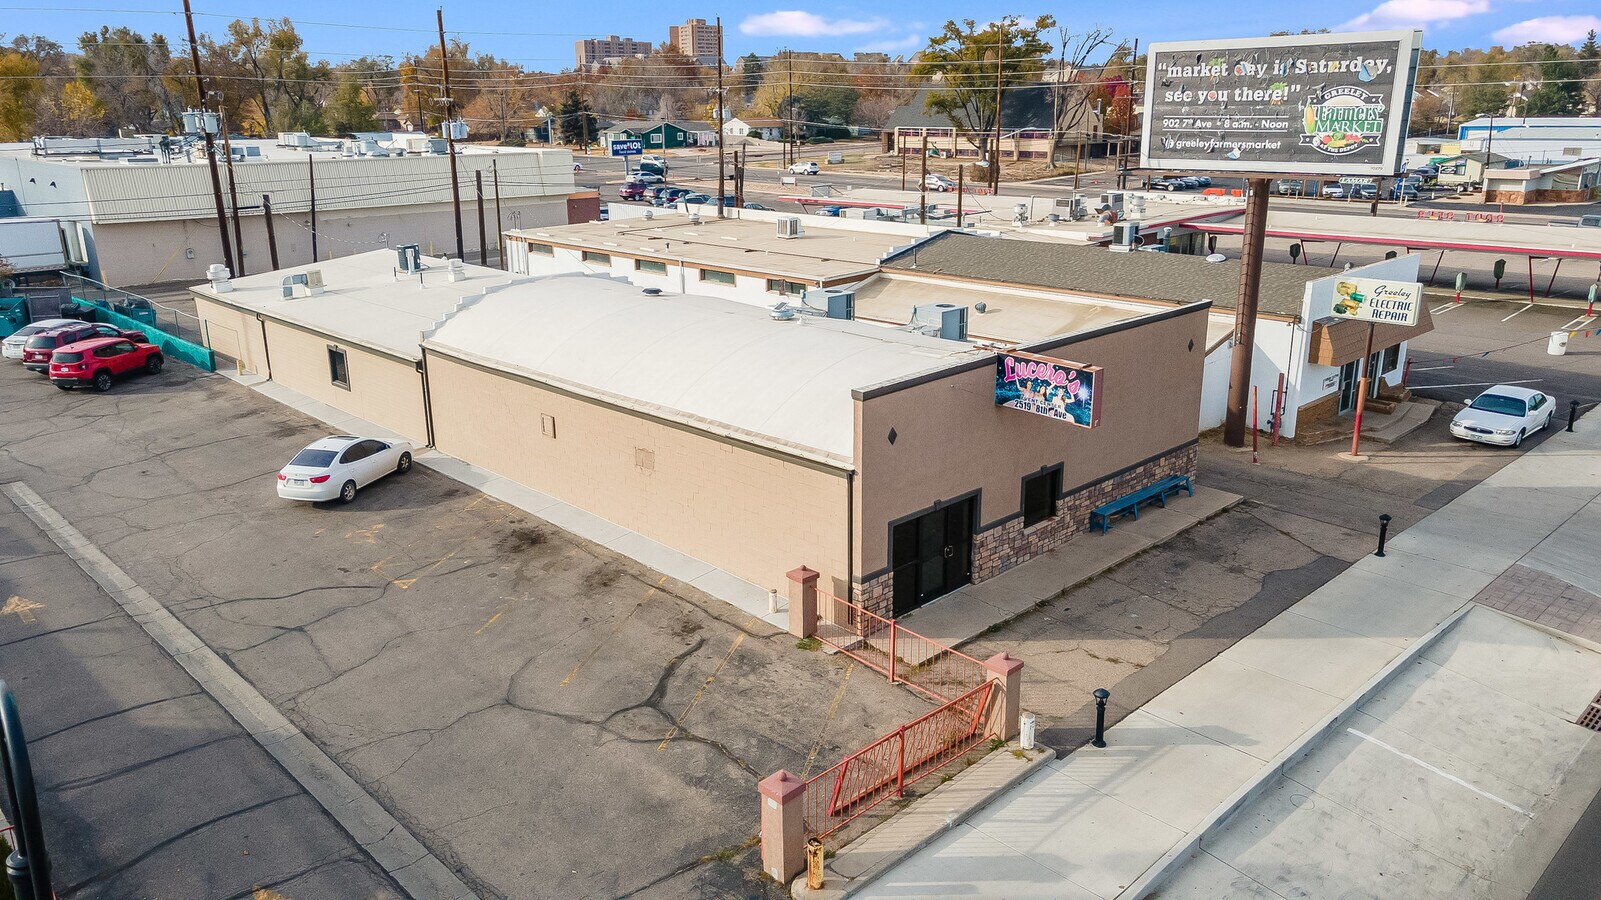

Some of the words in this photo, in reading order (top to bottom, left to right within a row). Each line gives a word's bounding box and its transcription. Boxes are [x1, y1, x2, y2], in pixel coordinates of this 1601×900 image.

[1165, 89, 1193, 102] see
[1198, 90, 1228, 104] you
[1324, 88, 1369, 100] GREELEY
[1162, 118, 1180, 128] 902
[1195, 119, 1212, 128] Ave
[1224, 119, 1230, 128] 8
[1261, 119, 1289, 129] Noon
[1316, 120, 1382, 133] MARKET
[1176, 138, 1282, 151] greeleyfarmersmarket
[1374, 285, 1411, 300] Greeley
[1369, 298, 1413, 311] ELECTRIC
[1371, 309, 1408, 322] REPAIR
[1004, 357, 1080, 394] Lucero's
[1014, 399, 1032, 411] 2519
[1035, 404, 1048, 415] 8th
[1053, 409, 1067, 419] Ave
